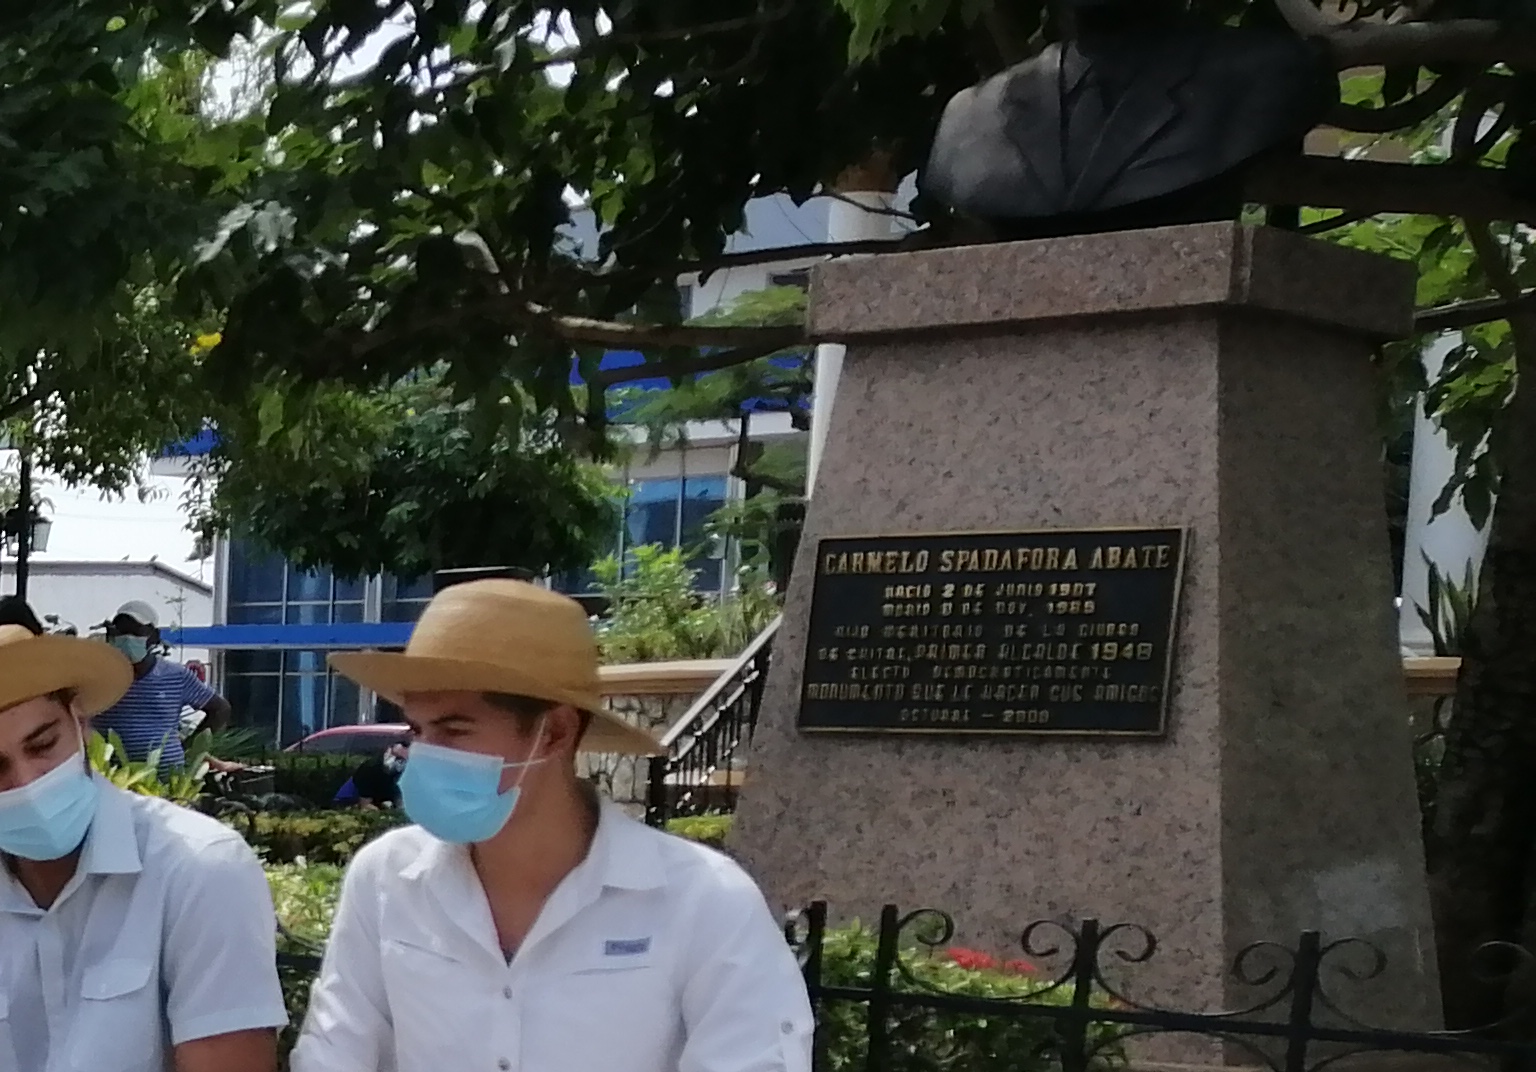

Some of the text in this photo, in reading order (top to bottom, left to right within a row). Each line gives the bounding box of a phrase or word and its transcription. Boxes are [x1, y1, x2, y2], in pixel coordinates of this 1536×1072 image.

[825, 544, 1171, 575] CARMELO SPADAFORA ABATE
[884, 582, 1097, 598] NACIO 2 DE JUNIO 1907
[962, 602, 984, 616] DE
[1004, 624, 1029, 638] DE
[818, 647, 840, 661] DE
[997, 642, 1083, 661] ALCALDE
[850, 665, 911, 680] ELECTO
[807, 683, 907, 700] MONUMENTO
[912, 683, 946, 700] QUE
[950, 684, 974, 700] LE
